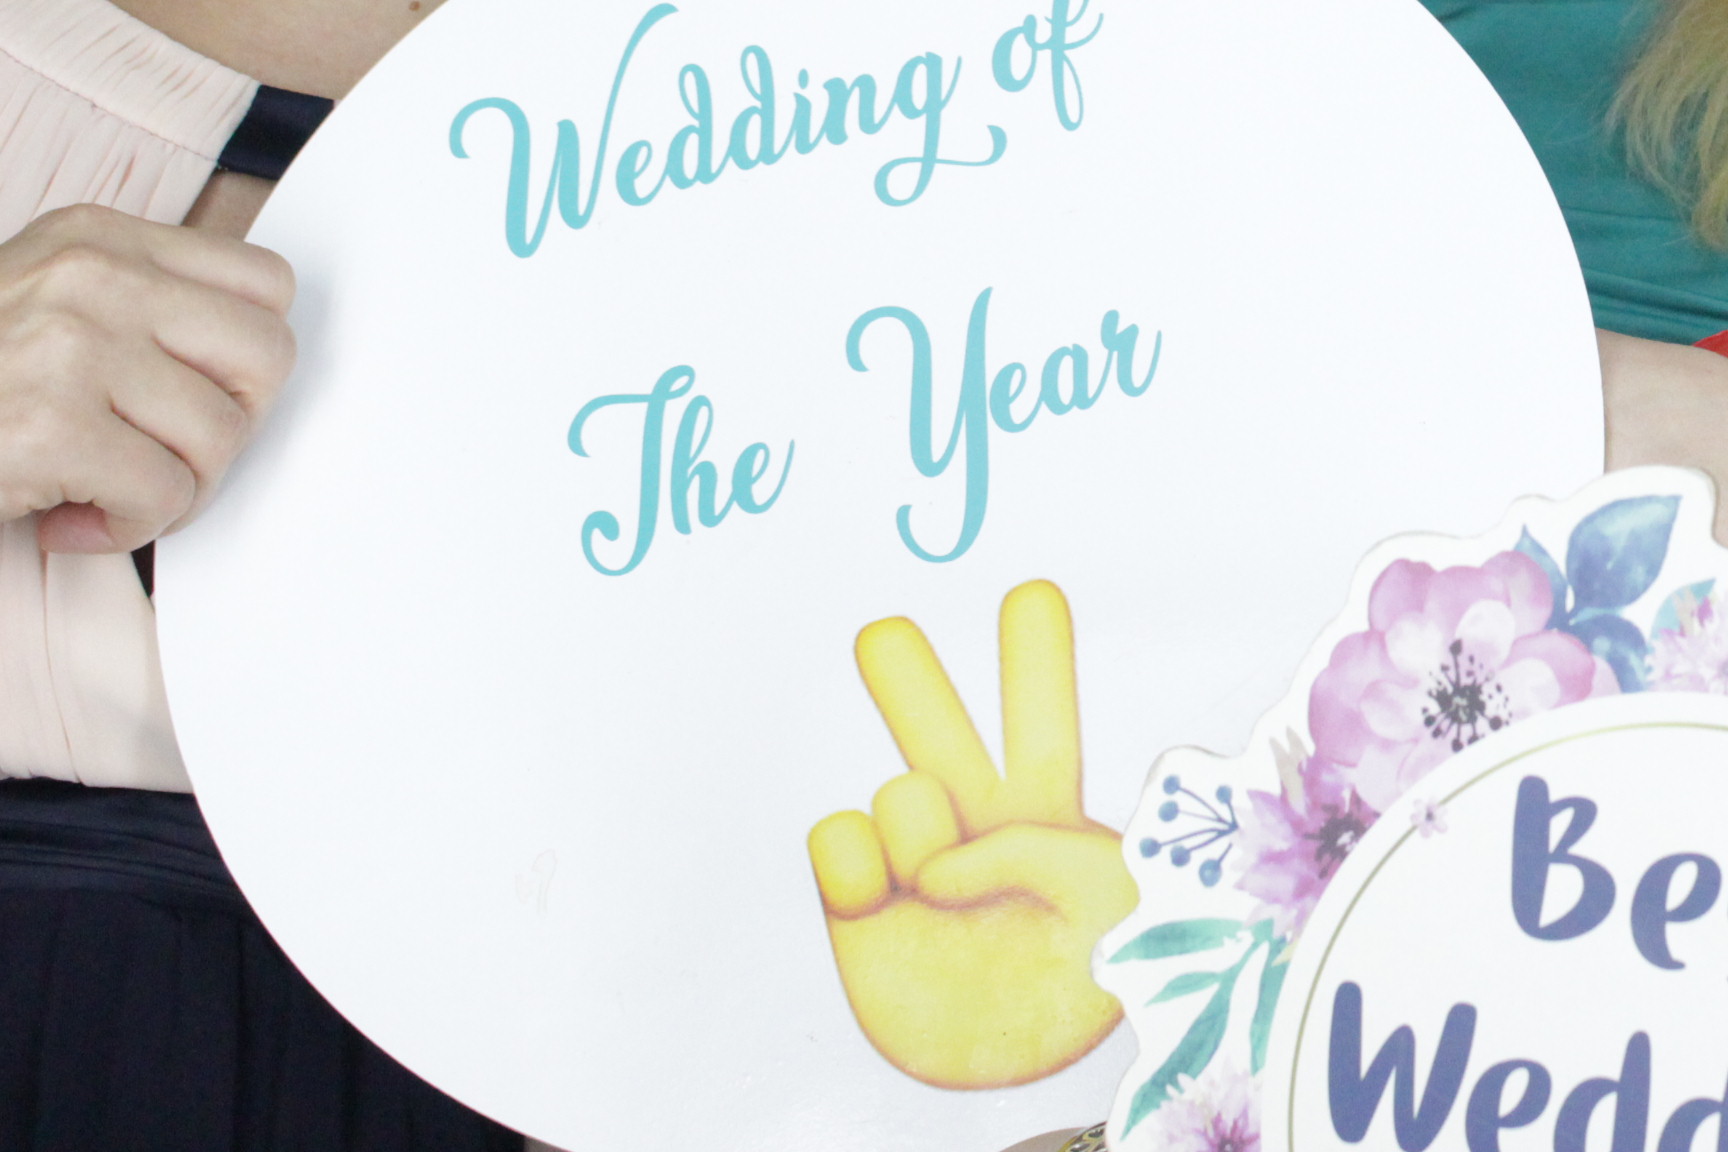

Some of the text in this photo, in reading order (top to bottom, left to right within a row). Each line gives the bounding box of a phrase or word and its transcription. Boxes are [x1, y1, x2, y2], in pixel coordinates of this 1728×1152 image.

[448, 1, 1008, 259] Wedding
[567, 286, 1163, 577] The Year
